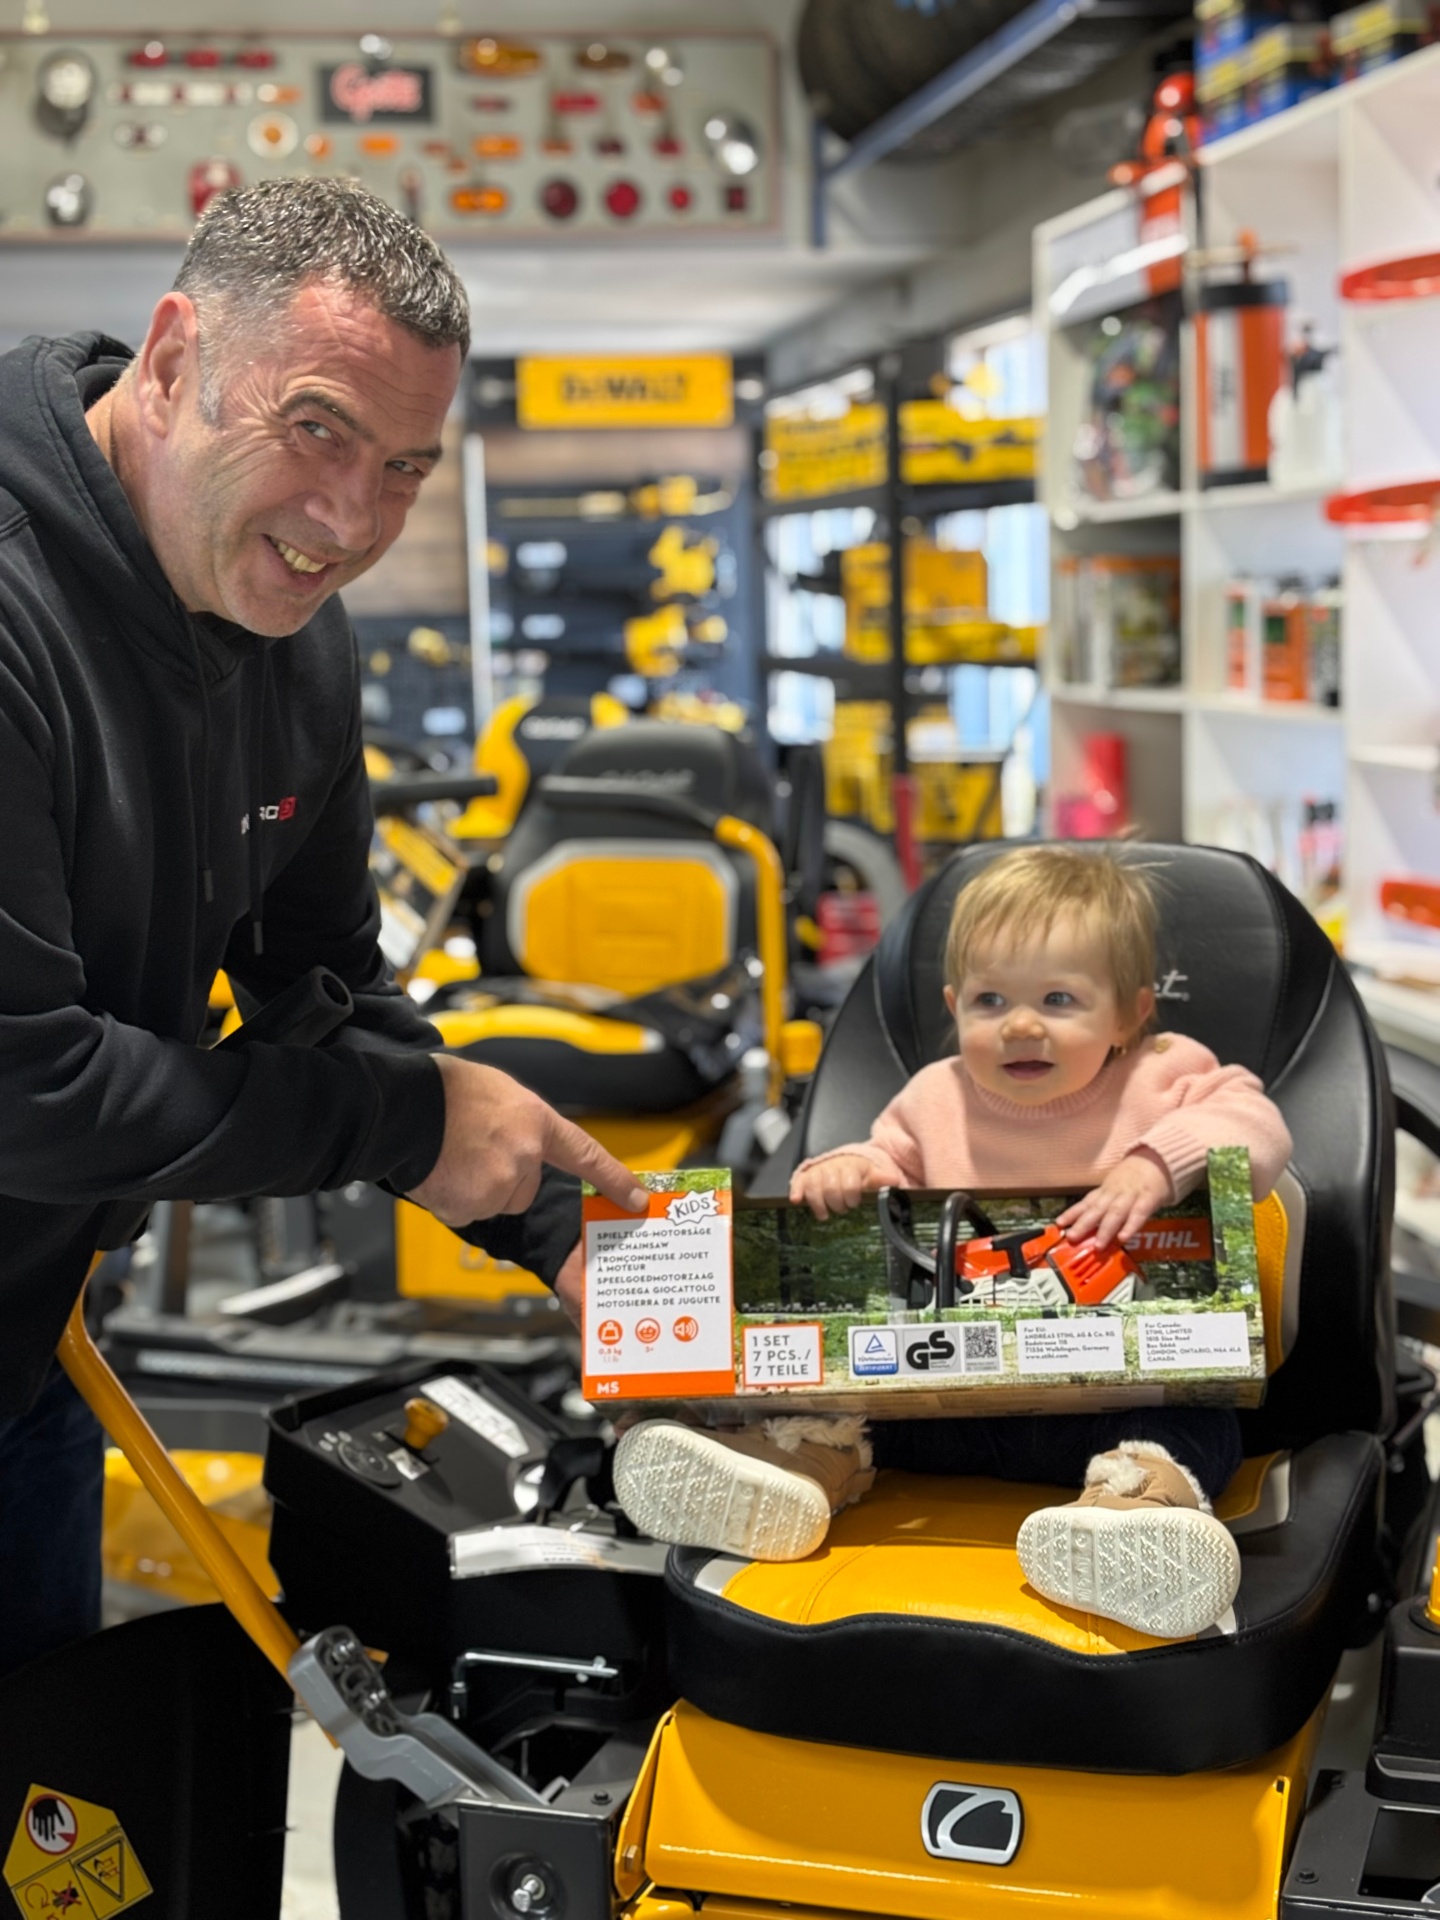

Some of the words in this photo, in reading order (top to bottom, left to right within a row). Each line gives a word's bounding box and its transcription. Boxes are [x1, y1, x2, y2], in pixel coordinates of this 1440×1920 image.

[674, 1197, 711, 1218] KIDS
[597, 1228, 712, 1240] SPIELZEUG-MOTORSÄGE
[1124, 1230, 1200, 1250] STIHL
[597, 1243, 616, 1252] TOY
[619, 1241, 670, 1251] CHAINSAW
[597, 1252, 676, 1266] TRONÇONNEUSE
[678, 1250, 710, 1261] JOUET
[606, 1263, 646, 1272] MOTEUR
[597, 1272, 714, 1284] SPEELGOEDMOTORZAAG
[597, 1286, 650, 1297] MOTOSEGA
[653, 1283, 716, 1295] GIOCATTOLO
[597, 1298, 660, 1309] MOTOSIERRA
[663, 1297, 675, 1306] DE
[678, 1295, 721, 1305] JUGUETE
[763, 1334, 791, 1347] SET
[753, 1350, 762, 1362] 7
[767, 1349, 802, 1362] PCS.
[906, 1329, 956, 1371] GS
[753, 1365, 762, 1377] 7
[767, 1363, 810, 1377] TEILE
[596, 1380, 620, 1395] MS
